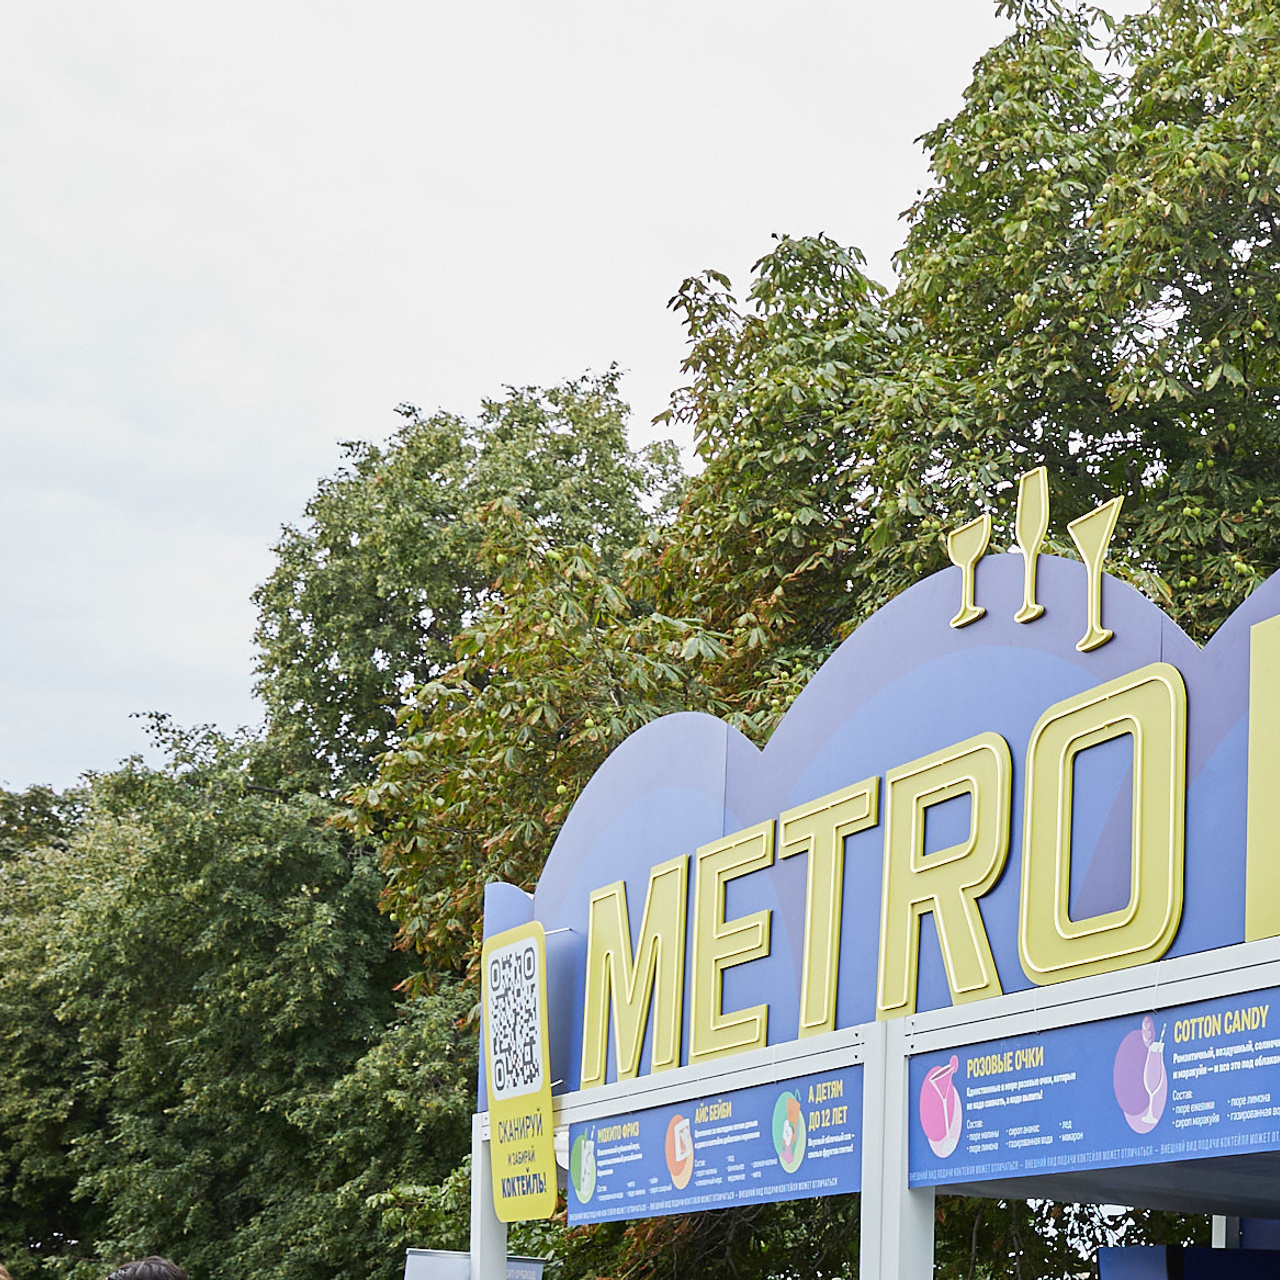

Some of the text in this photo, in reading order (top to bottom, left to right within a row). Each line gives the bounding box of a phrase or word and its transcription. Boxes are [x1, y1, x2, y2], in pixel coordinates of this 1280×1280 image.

[581, 662, 1187, 1090] METRO
[1174, 1004, 1269, 1043] COTTON CANDY
[967, 1046, 1044, 1078] РОЗОВЫЕ ОЧКИ
[808, 1081, 843, 1104] А ДЕТЯМ
[498, 1107, 543, 1143] СКАНИРУЙ
[809, 1106, 848, 1132] ДО 12 ЛЕТ
[508, 1146, 535, 1166] И ЗАБИРАЙ
[501, 1167, 547, 1198] КОКТЕЙЛЬ!
